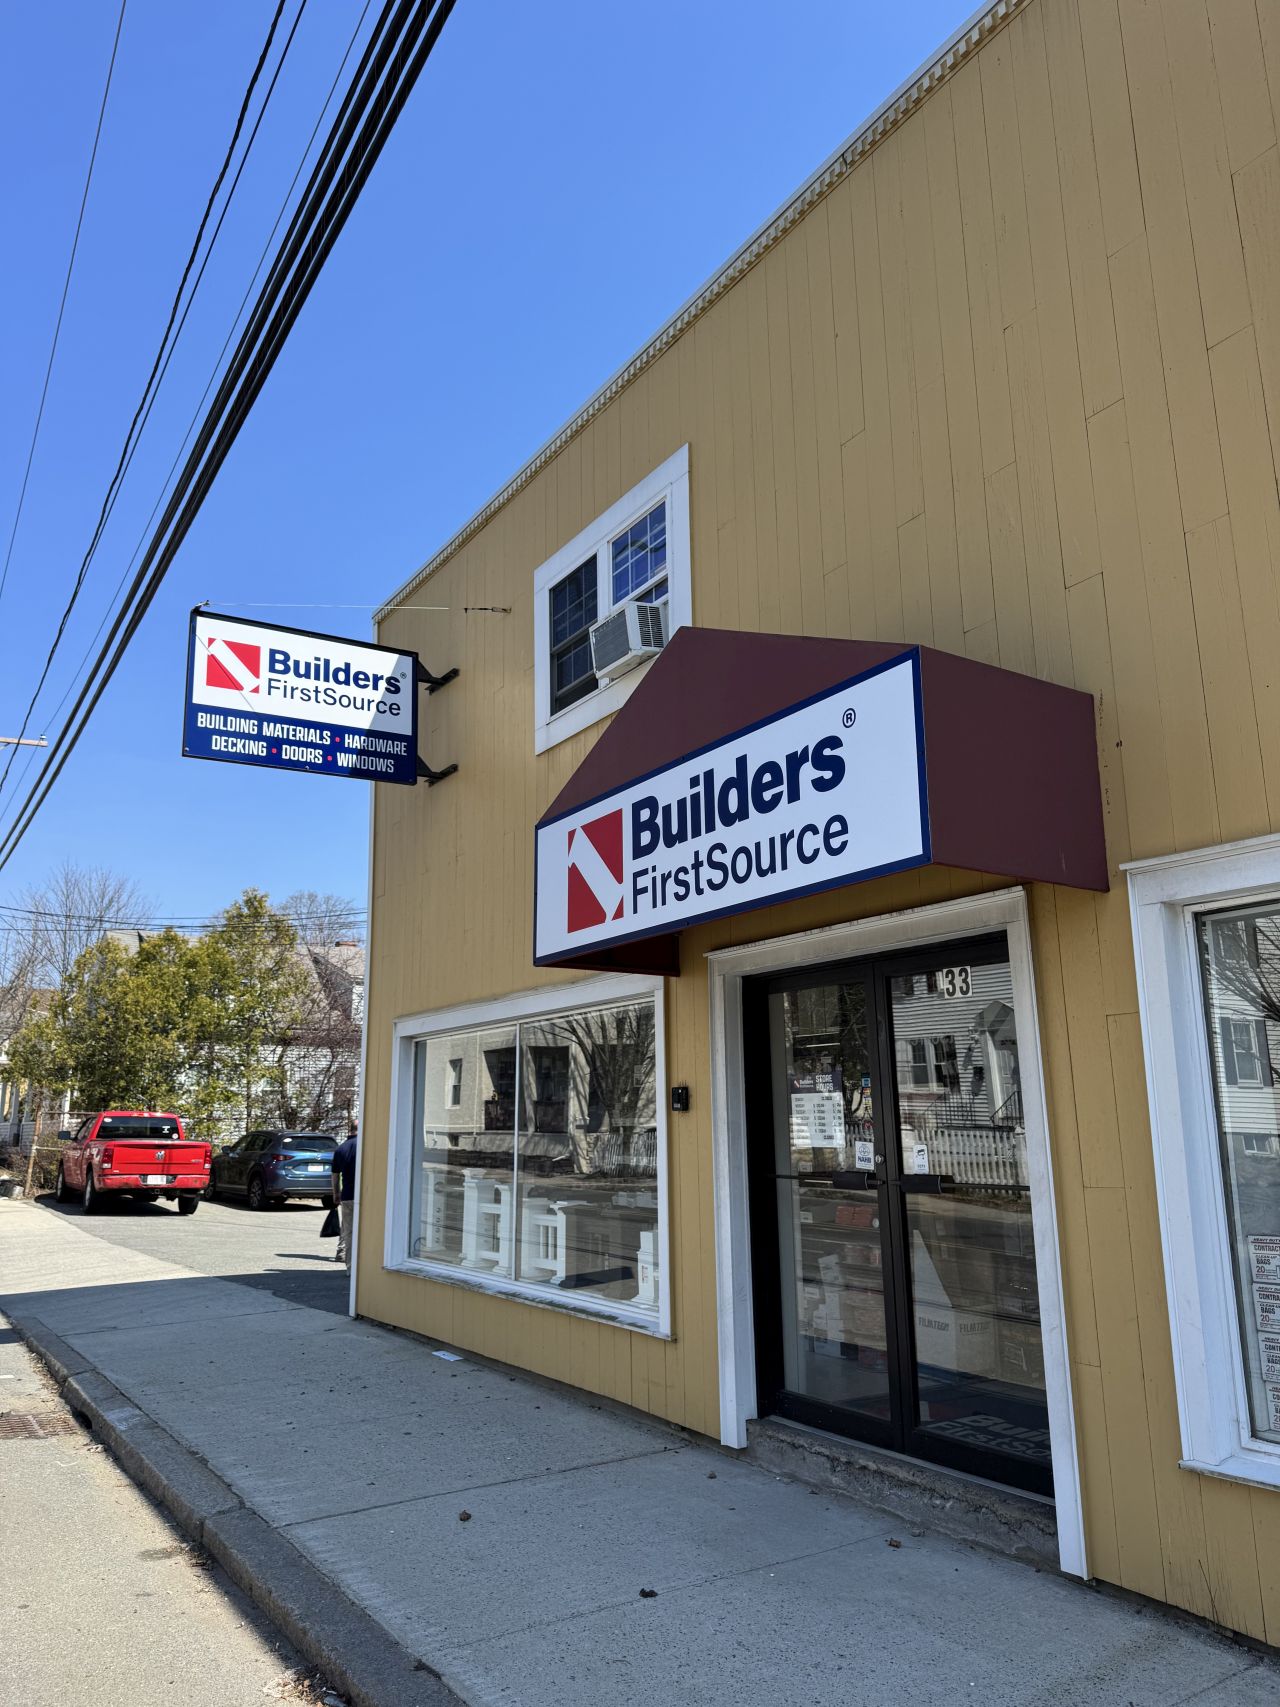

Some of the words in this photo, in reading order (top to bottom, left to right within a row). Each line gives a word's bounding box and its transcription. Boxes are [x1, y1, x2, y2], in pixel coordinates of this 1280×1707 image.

[267, 678, 401, 716] FirstSource
[197, 712, 258, 735] BUILDING
[262, 722, 331, 745] MATERIALS
[344, 734, 408, 756] HARDWARE
[211, 735, 267, 756] DECKING
[281, 744, 323, 764] DOORS
[336, 752, 395, 773] WINDOWS
[632, 814, 849, 915] FirstSource
[945, 967, 971, 997] 33
[1255, 1265, 1266, 1273] 20
[1260, 1306, 1276, 1314] BAGS
[1260, 1314, 1270, 1323] 20
[1266, 1365, 1276, 1373] 20
